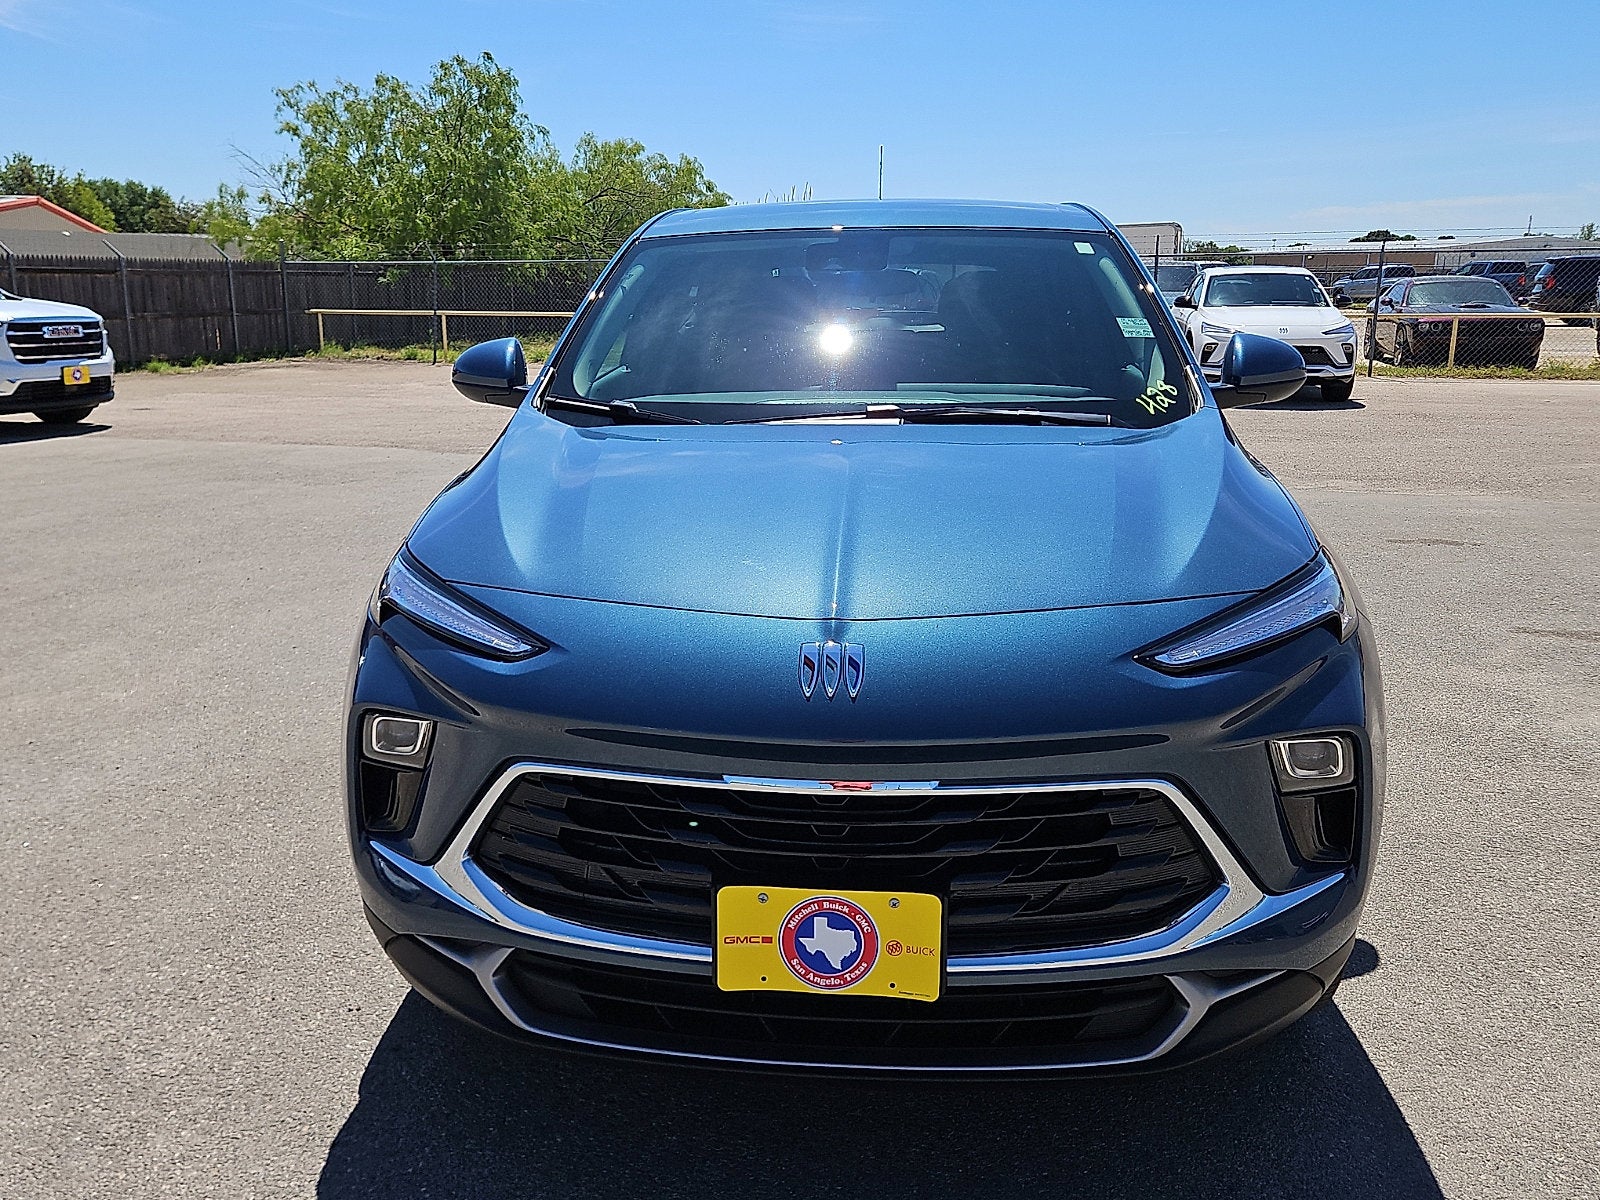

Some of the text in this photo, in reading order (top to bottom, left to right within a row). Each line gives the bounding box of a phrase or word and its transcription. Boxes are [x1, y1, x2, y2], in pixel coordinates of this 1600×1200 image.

[1135, 380, 1178, 415] 428
[787, 901, 872, 934] Mitchell Buick GMC
[723, 935, 761, 945] GMC
[905, 945, 936, 957] BUICK
[790, 958, 868, 986] San Angelo, Texas
